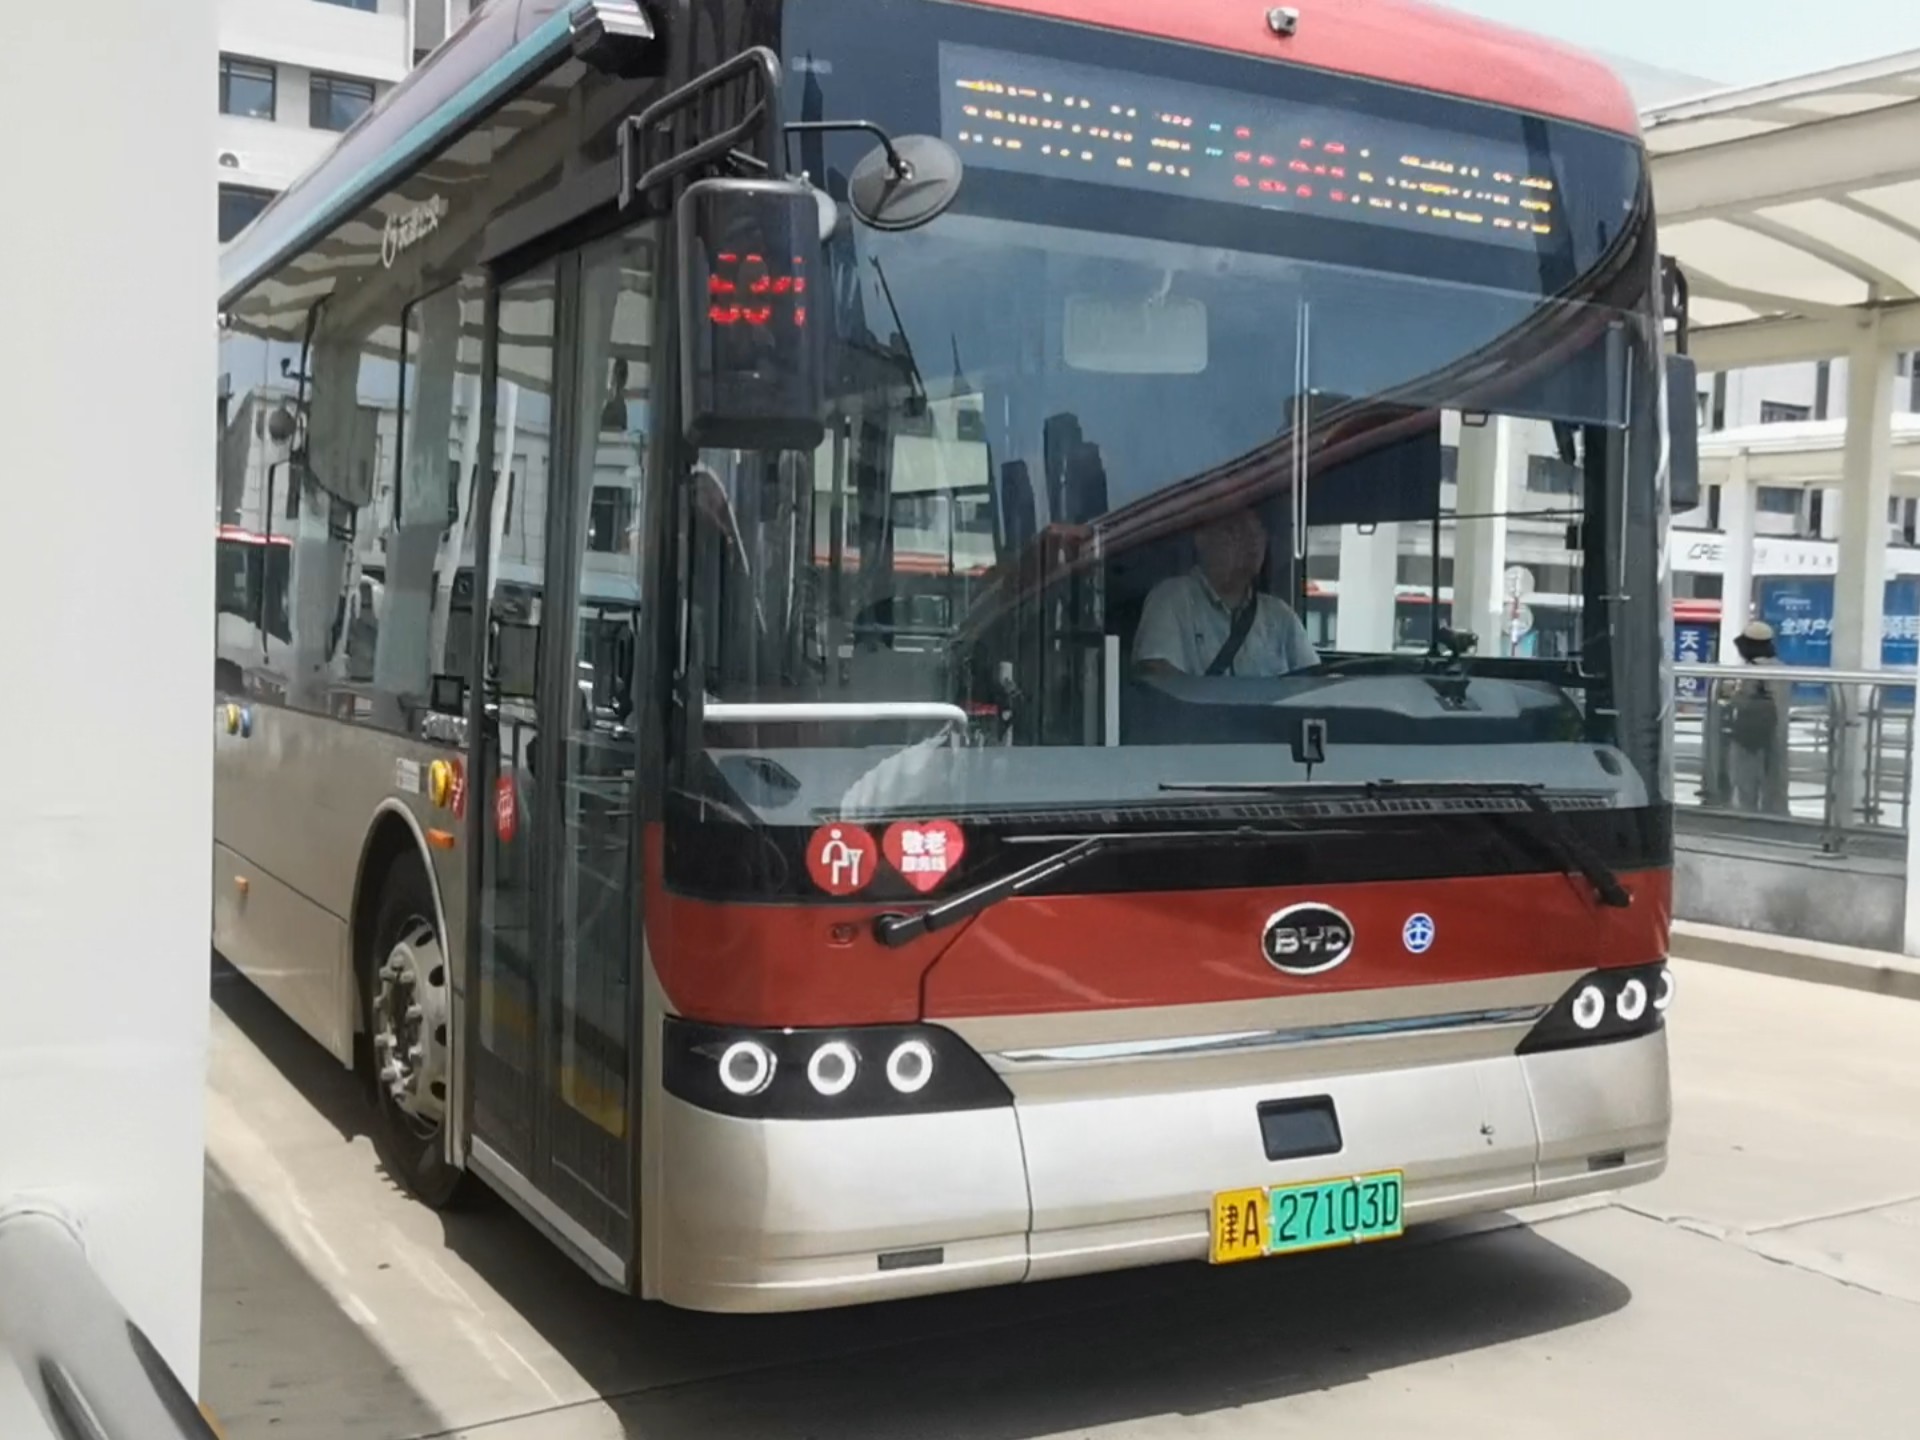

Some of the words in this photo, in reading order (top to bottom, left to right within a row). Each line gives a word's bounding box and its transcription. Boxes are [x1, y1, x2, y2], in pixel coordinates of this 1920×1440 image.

[1780, 617, 1832, 636] 全球户
[1274, 925, 1346, 954] BYD
